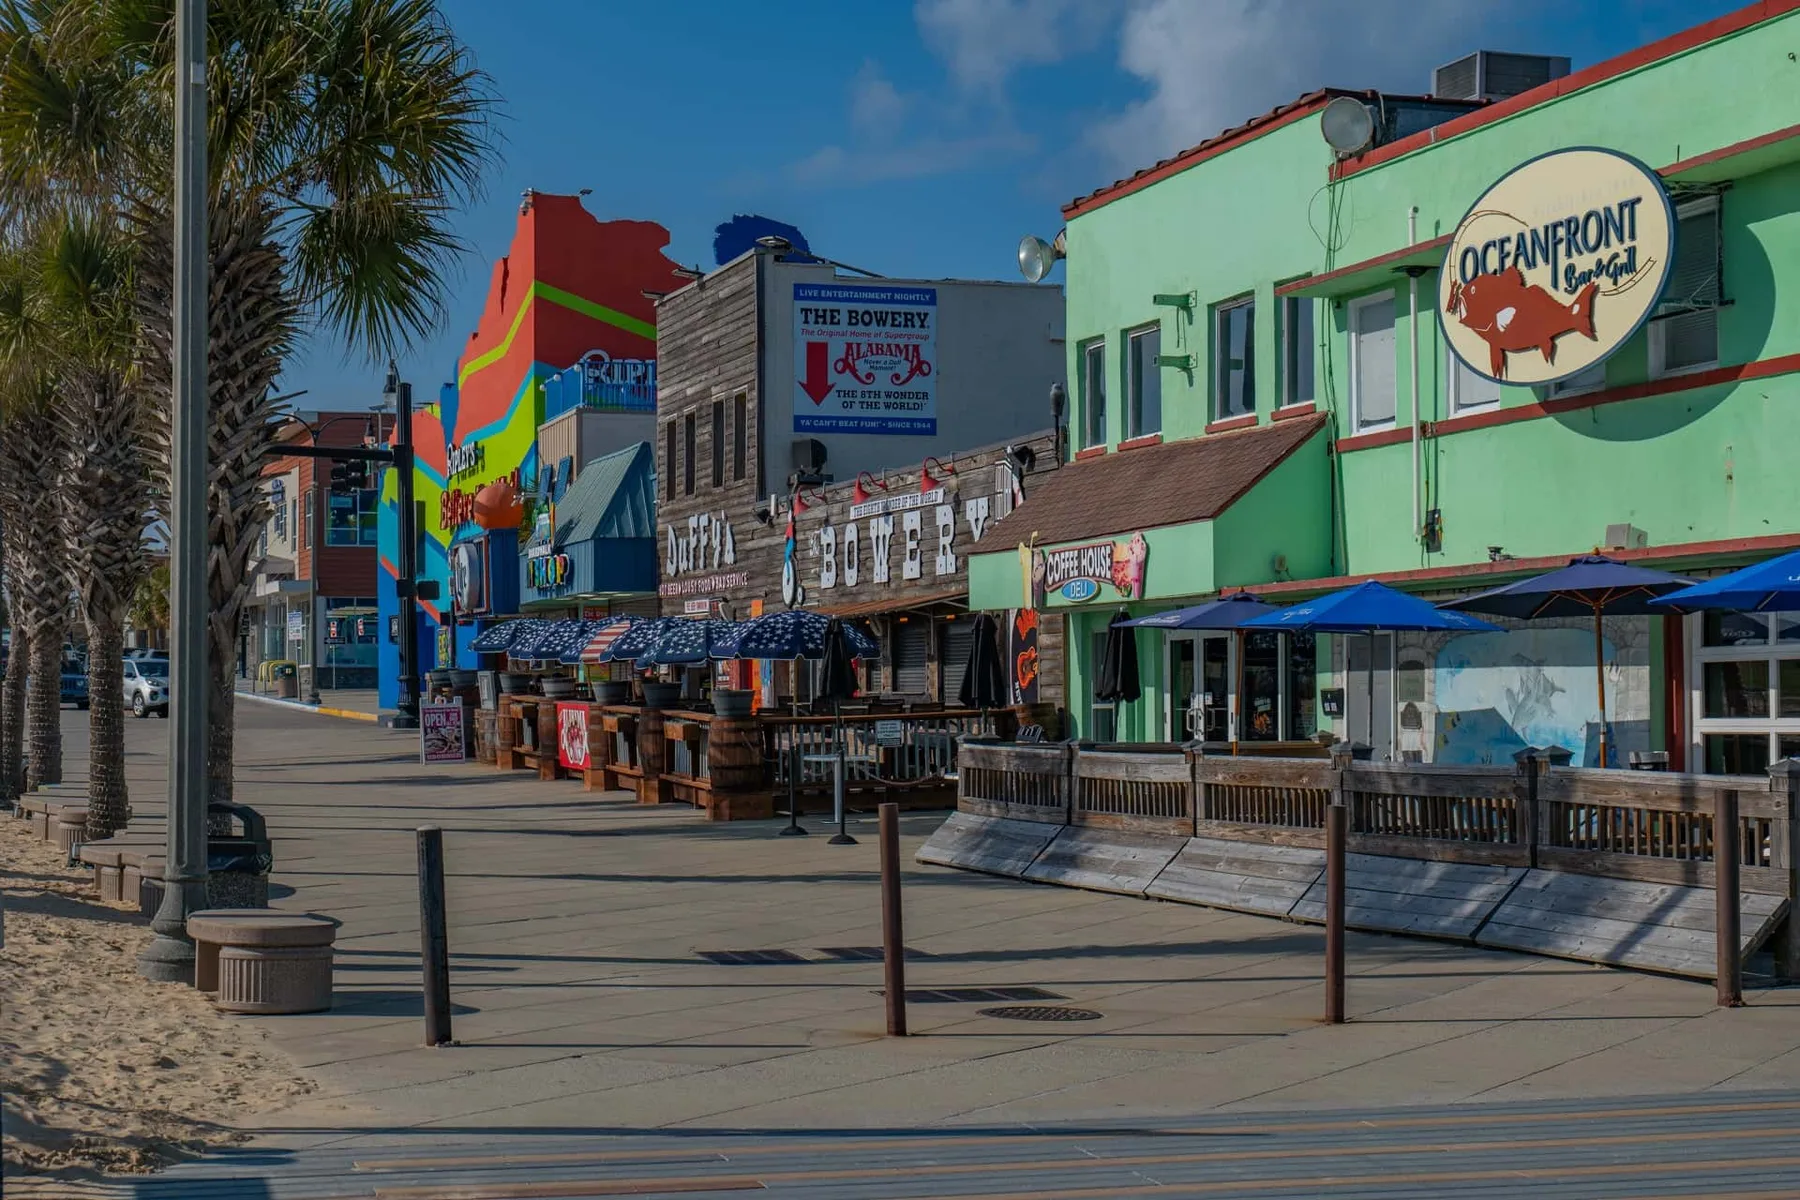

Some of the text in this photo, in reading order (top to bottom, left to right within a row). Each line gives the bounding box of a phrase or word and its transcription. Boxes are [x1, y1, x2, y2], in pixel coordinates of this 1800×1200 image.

[1459, 197, 1642, 291] OCEANFRONT
[799, 289, 931, 301] LIVE ENTERTAINMENT NIGHTLY
[800, 308, 929, 329] THE BOWERY
[817, 329, 848, 339] Original
[849, 330, 871, 338] Home
[873, 331, 883, 339] of
[884, 331, 929, 341] Supergroup
[836, 390, 929, 400] THE 8TH WONDER
[842, 401, 923, 411] OF THE WORLD!
[854, 506, 862, 517] THE
[909, 495, 919, 506] THE
[1047, 545, 1111, 585] COFFEE HOUSE
[1070, 581, 1088, 597] DELI
[424, 713, 447, 728] OPEN
